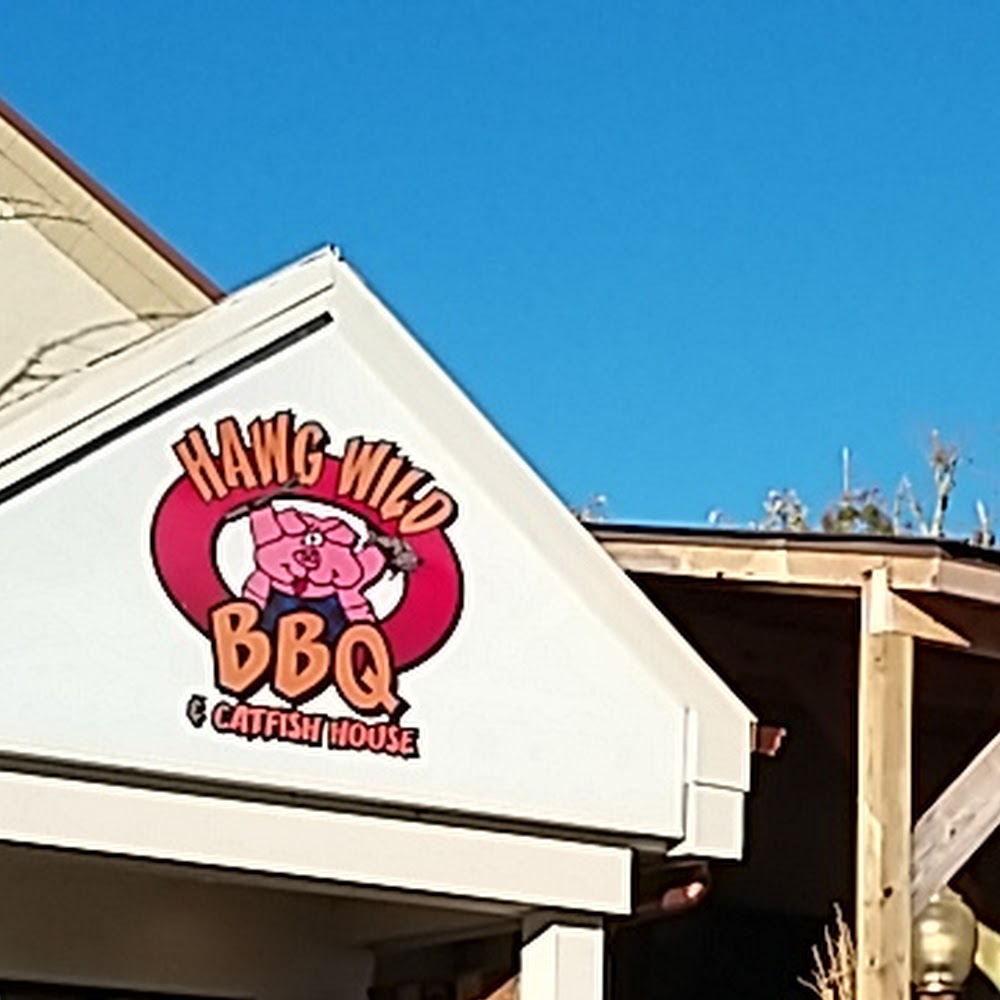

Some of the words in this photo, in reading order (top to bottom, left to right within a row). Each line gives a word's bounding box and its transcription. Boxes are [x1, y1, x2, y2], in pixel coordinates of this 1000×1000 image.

[172, 409, 330, 502] HAWG
[338, 436, 458, 534] WILD
[209, 598, 411, 717] BBQ
[212, 701, 323, 747] CATFISH
[328, 717, 419, 759] HOUSE
